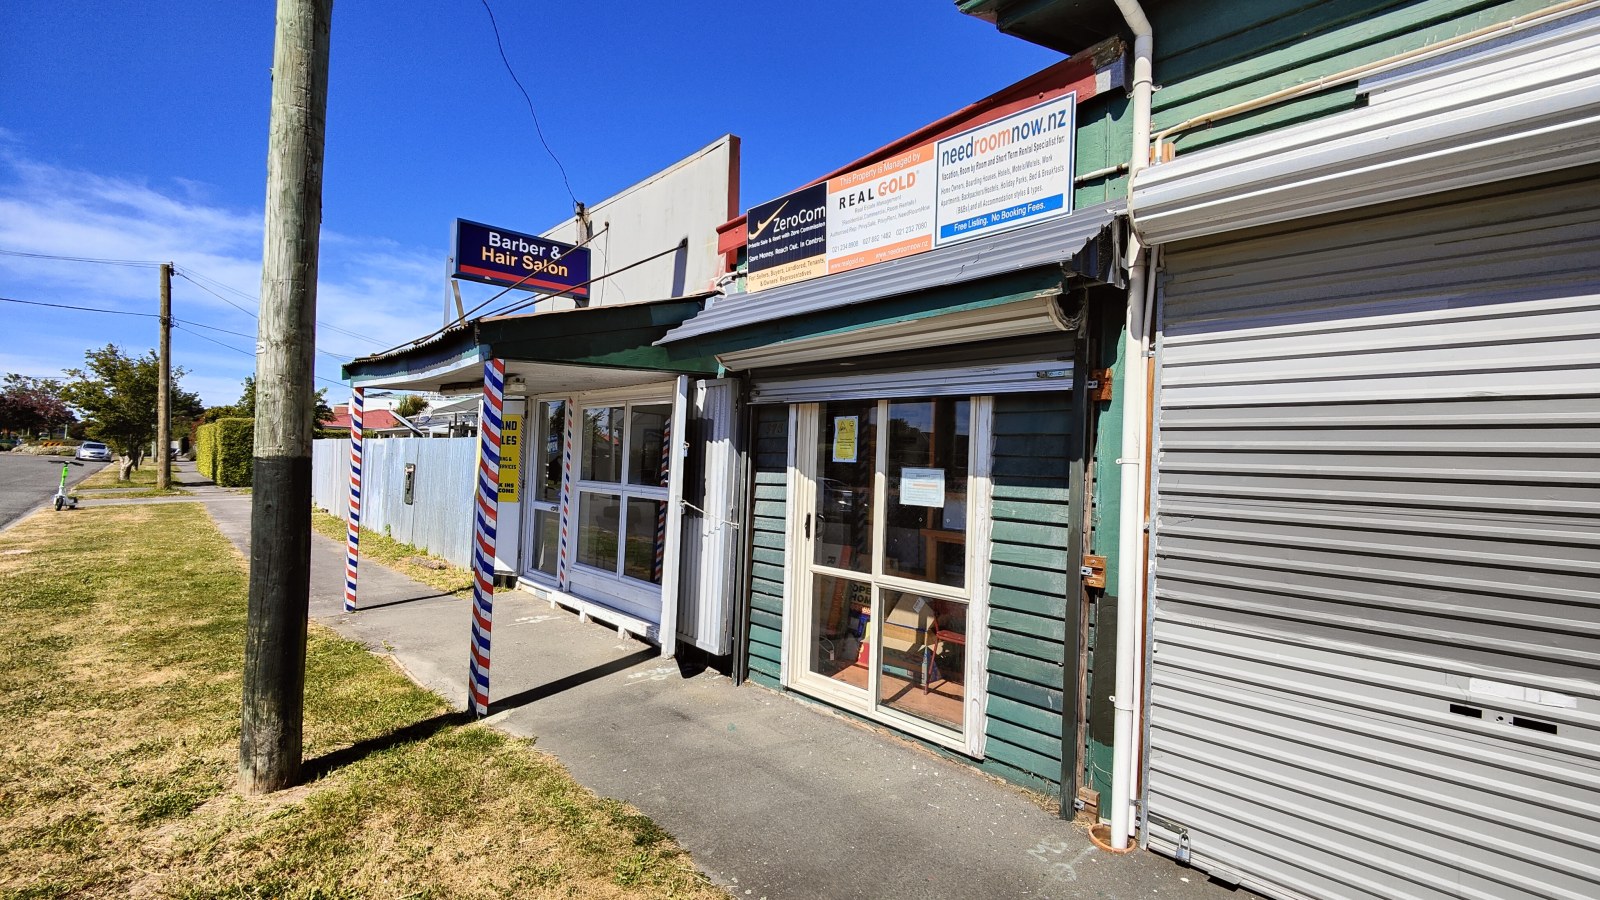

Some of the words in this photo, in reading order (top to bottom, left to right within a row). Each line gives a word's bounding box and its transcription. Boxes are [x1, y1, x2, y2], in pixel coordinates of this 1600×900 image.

[942, 109, 1066, 167] needroomnow.nz
[942, 170, 959, 180] Vacation,
[960, 167, 970, 175] Room
[971, 164, 975, 174] by
[976, 161, 987, 170] Room
[996, 153, 1007, 164] Short
[1008, 151, 1018, 159] Term
[1019, 144, 1033, 156] Rental
[1034, 137, 1056, 152] Specialist
[1056, 135, 1064, 144] for:
[840, 177, 852, 186] This
[852, 169, 877, 182] Property
[883, 155, 912, 172] Managed
[912, 153, 920, 162] by
[951, 183, 965, 192] Owners,
[966, 178, 982, 188] Boarding
[982, 173, 997, 182] Houses,
[998, 168, 1011, 178] Hotels,
[1042, 154, 1052, 163] Work
[1000, 180, 1015, 189] Holiday
[1016, 176, 1028, 185] Parks,
[1029, 173, 1037, 181] Bed
[1038, 170, 1041, 178] &
[1042, 165, 1064, 177] Breakfasts
[839, 188, 874, 210] REAL
[878, 172, 916, 196] GOLD
[876, 194, 902, 206] Management
[983, 194, 1013, 207] Accommodation
[1014, 189, 1026, 199] styles
[1030, 185, 1043, 195] types.
[773, 206, 825, 233] ZeroCom
[968, 217, 988, 228] Listing.
[991, 213, 1000, 222] No
[1001, 207, 1026, 219] Booking
[1028, 202, 1045, 212] Fees.
[800, 222, 825, 233] Commission
[896, 228, 904, 236] 021
[488, 231, 546, 257] Barber
[550, 245, 561, 260] &
[775, 246, 788, 254] Reach
[805, 235, 825, 246] Control.
[481, 246, 518, 267] Hair
[522, 255, 568, 277] Salon
[807, 258, 825, 266] Tenants,
[780, 270, 812, 282] Representatives
[501, 436, 517, 445] LES
[850, 594, 872, 604] HOM
[851, 584, 872, 595] OPE
